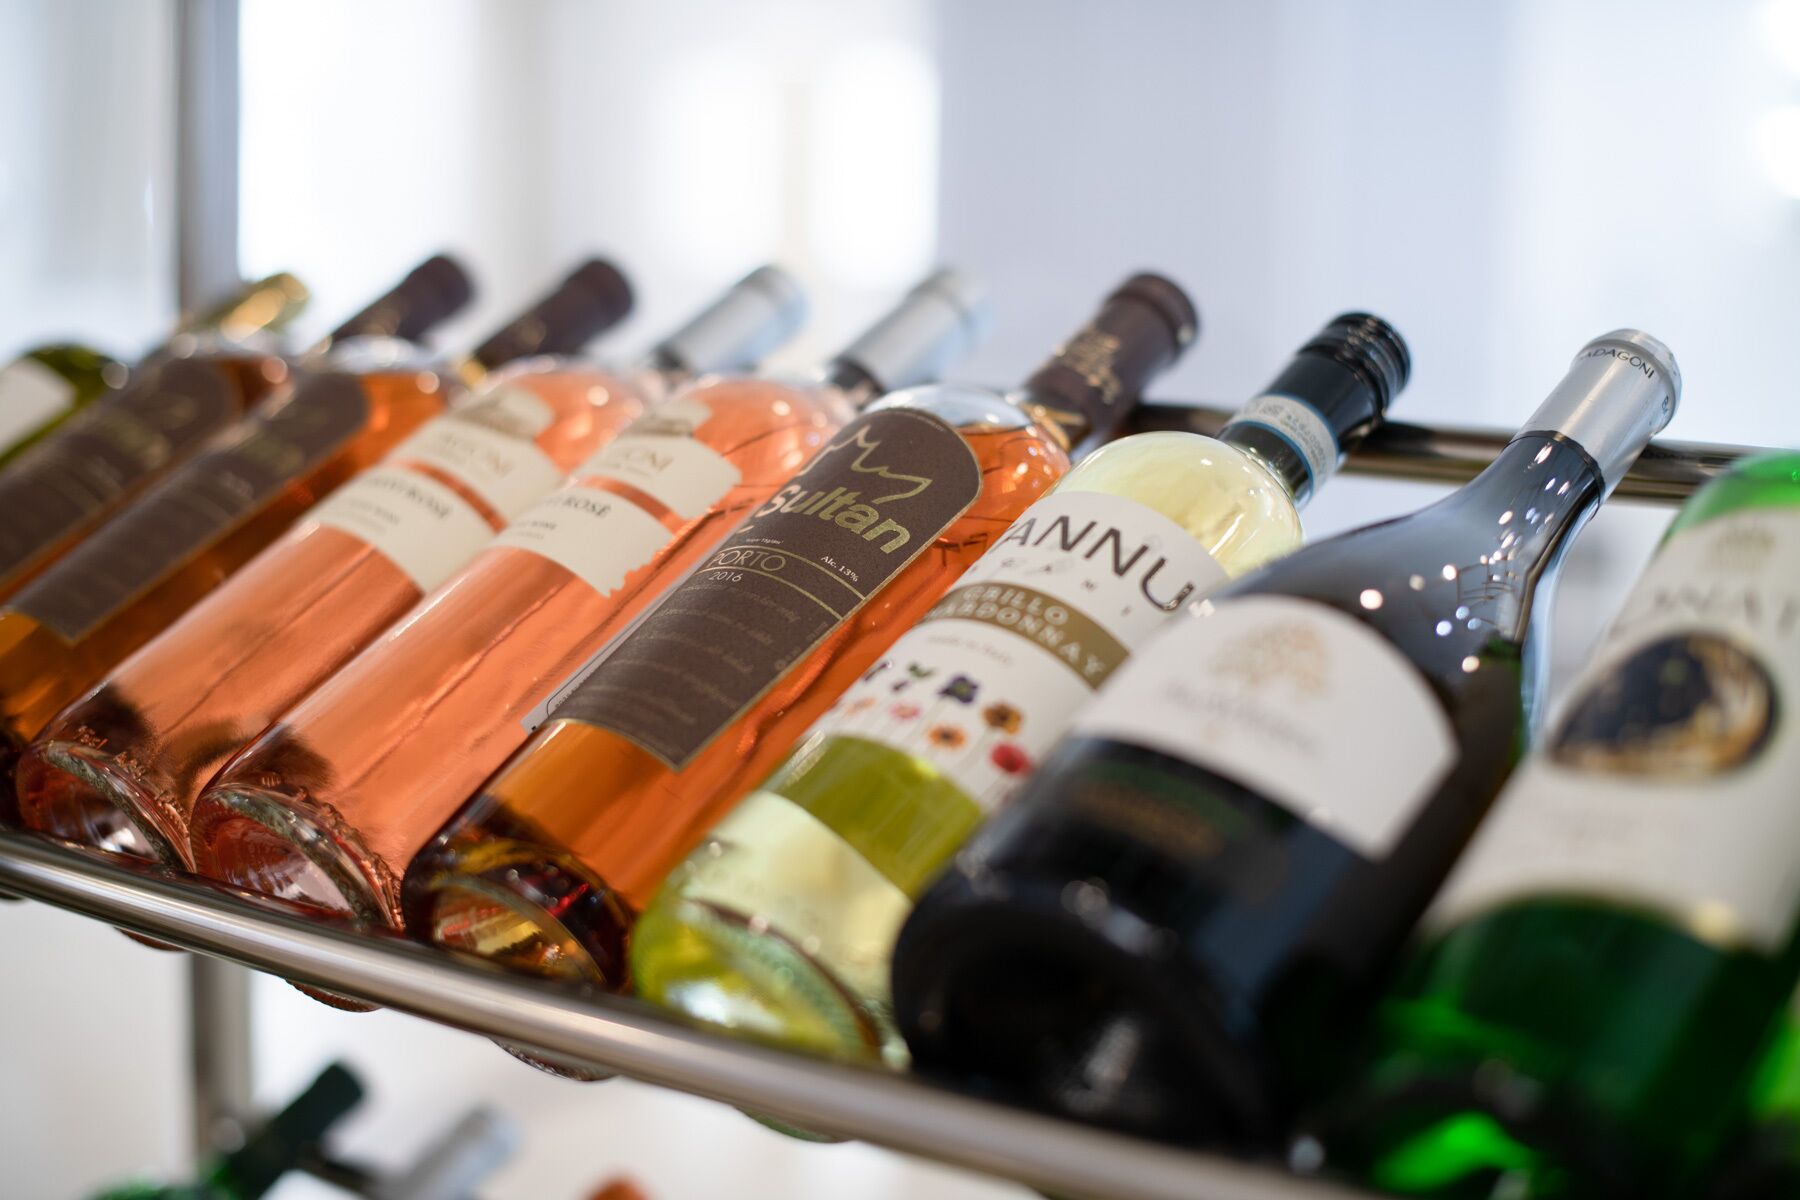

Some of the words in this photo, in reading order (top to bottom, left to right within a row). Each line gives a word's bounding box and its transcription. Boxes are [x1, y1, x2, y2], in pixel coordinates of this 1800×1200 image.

[755, 484, 911, 554] Sultan
[706, 549, 786, 571] PORTO
[820, 555, 838, 569] Alc.
[838, 564, 859, 583] 13%
[709, 571, 743, 583] 2016
[962, 584, 1069, 627] GRILLO
